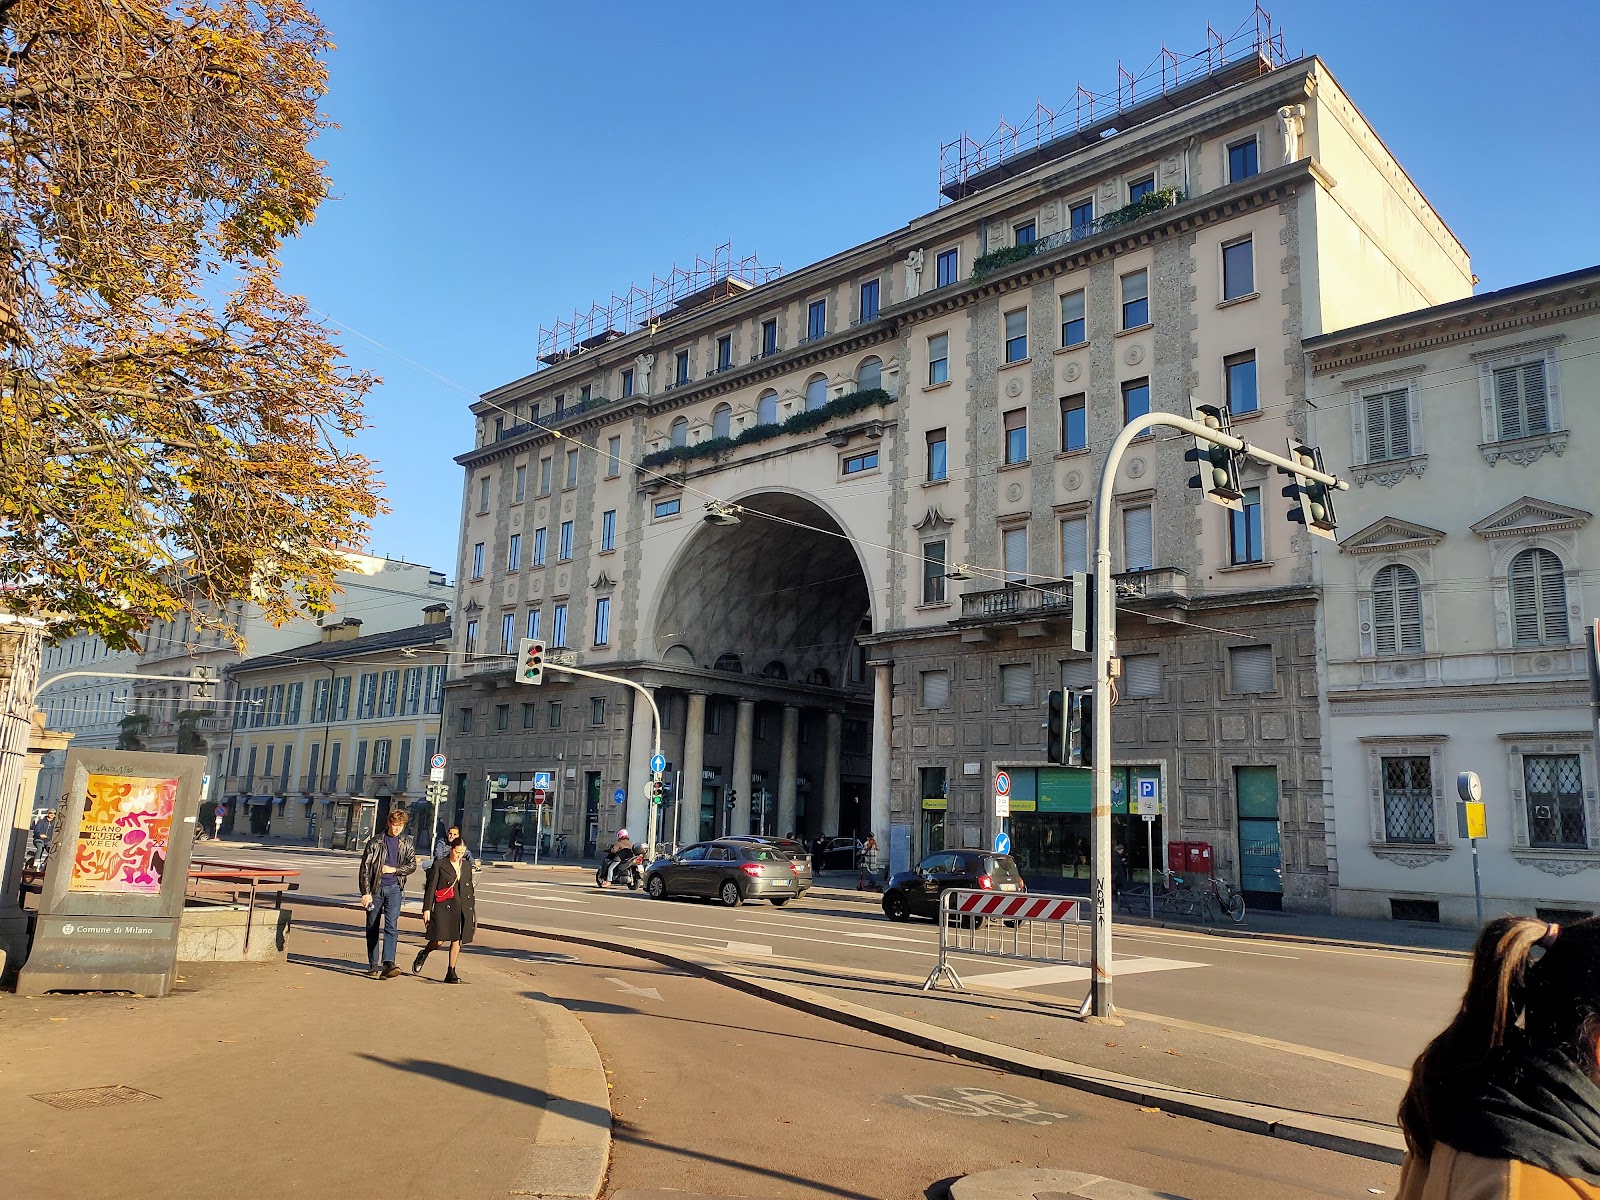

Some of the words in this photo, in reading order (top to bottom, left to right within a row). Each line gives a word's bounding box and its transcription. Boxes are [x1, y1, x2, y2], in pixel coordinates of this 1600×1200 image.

[1142, 783, 1152, 796] P
[85, 825, 122, 833] MILANO
[90, 832, 121, 840] MUSIC
[86, 840, 118, 848] WEEK
[77, 925, 111, 934] Comune
[114, 926, 122, 934] di
